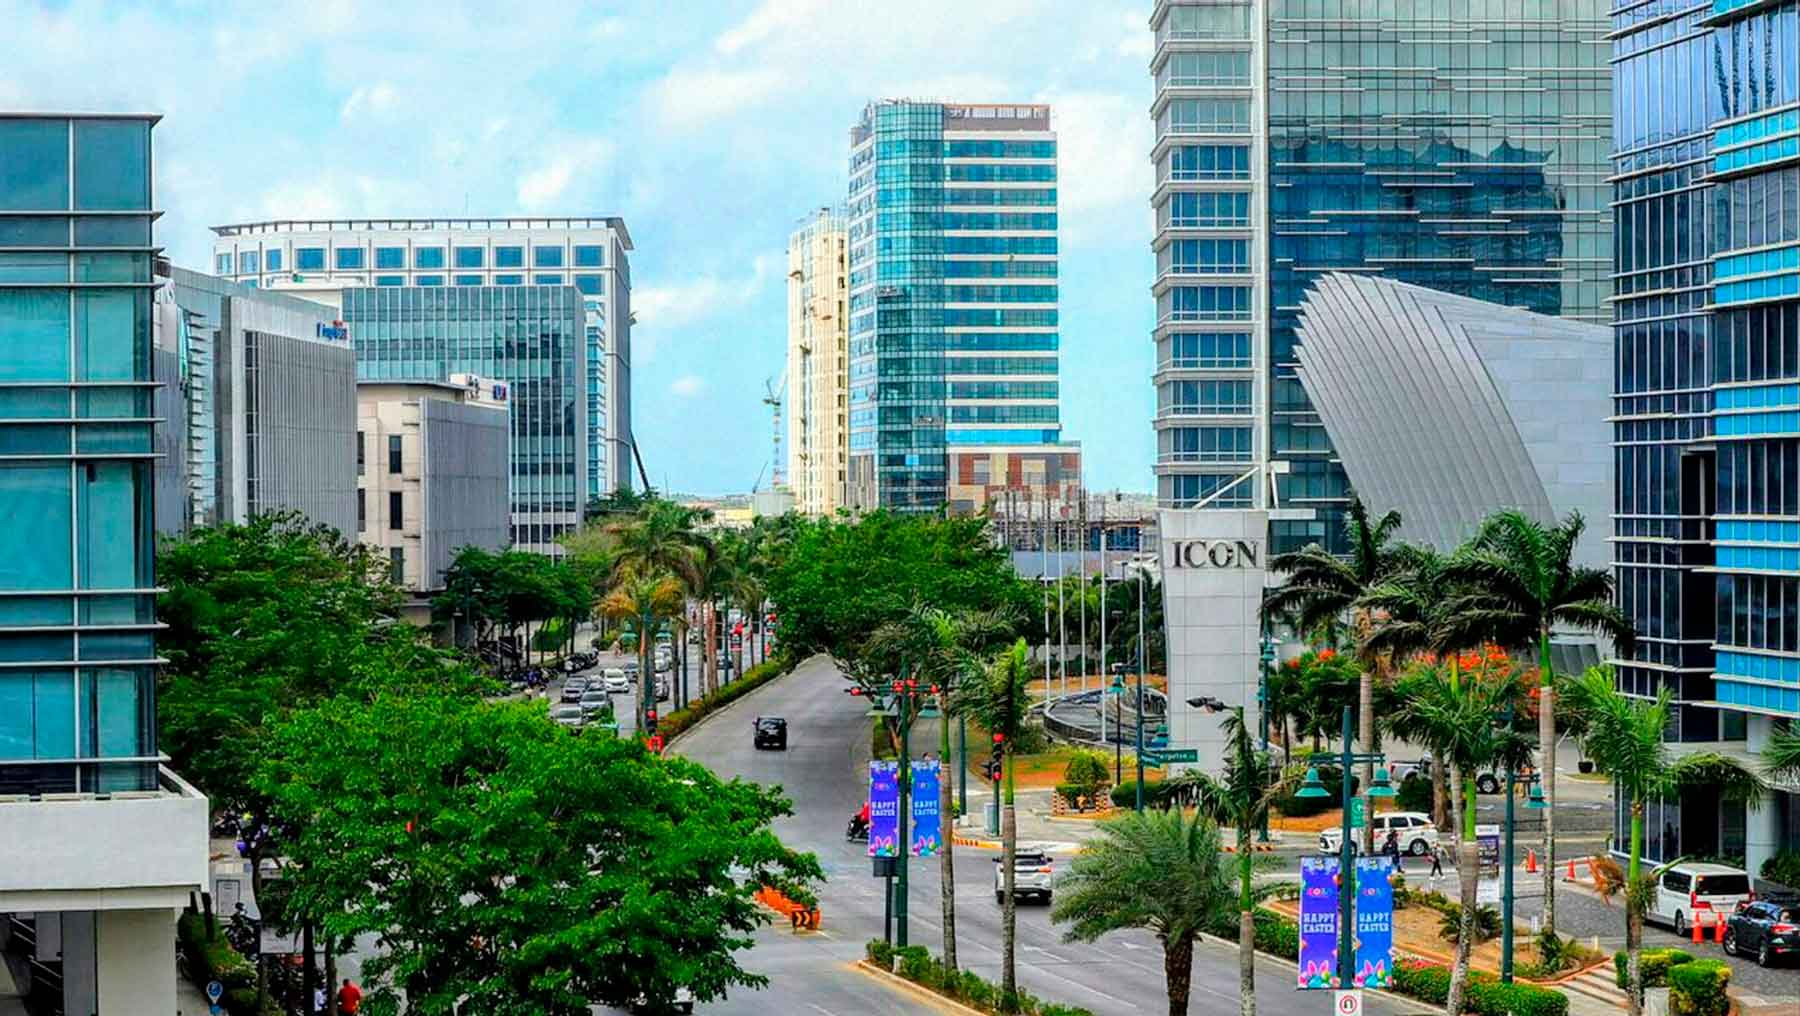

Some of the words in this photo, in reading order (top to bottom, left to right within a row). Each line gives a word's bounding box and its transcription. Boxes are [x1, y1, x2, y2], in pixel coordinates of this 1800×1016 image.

[1171, 541, 1259, 569] ICON
[871, 801, 896, 809] HAPPY
[914, 800, 938, 809] HAPPY
[871, 809, 896, 817] EASTER
[914, 808, 938, 816] EASTER
[1303, 912, 1335, 923] HAPPY
[1359, 912, 1390, 923] HAPPY
[1303, 923, 1335, 934] EASTER
[1359, 923, 1390, 933] EASTER
